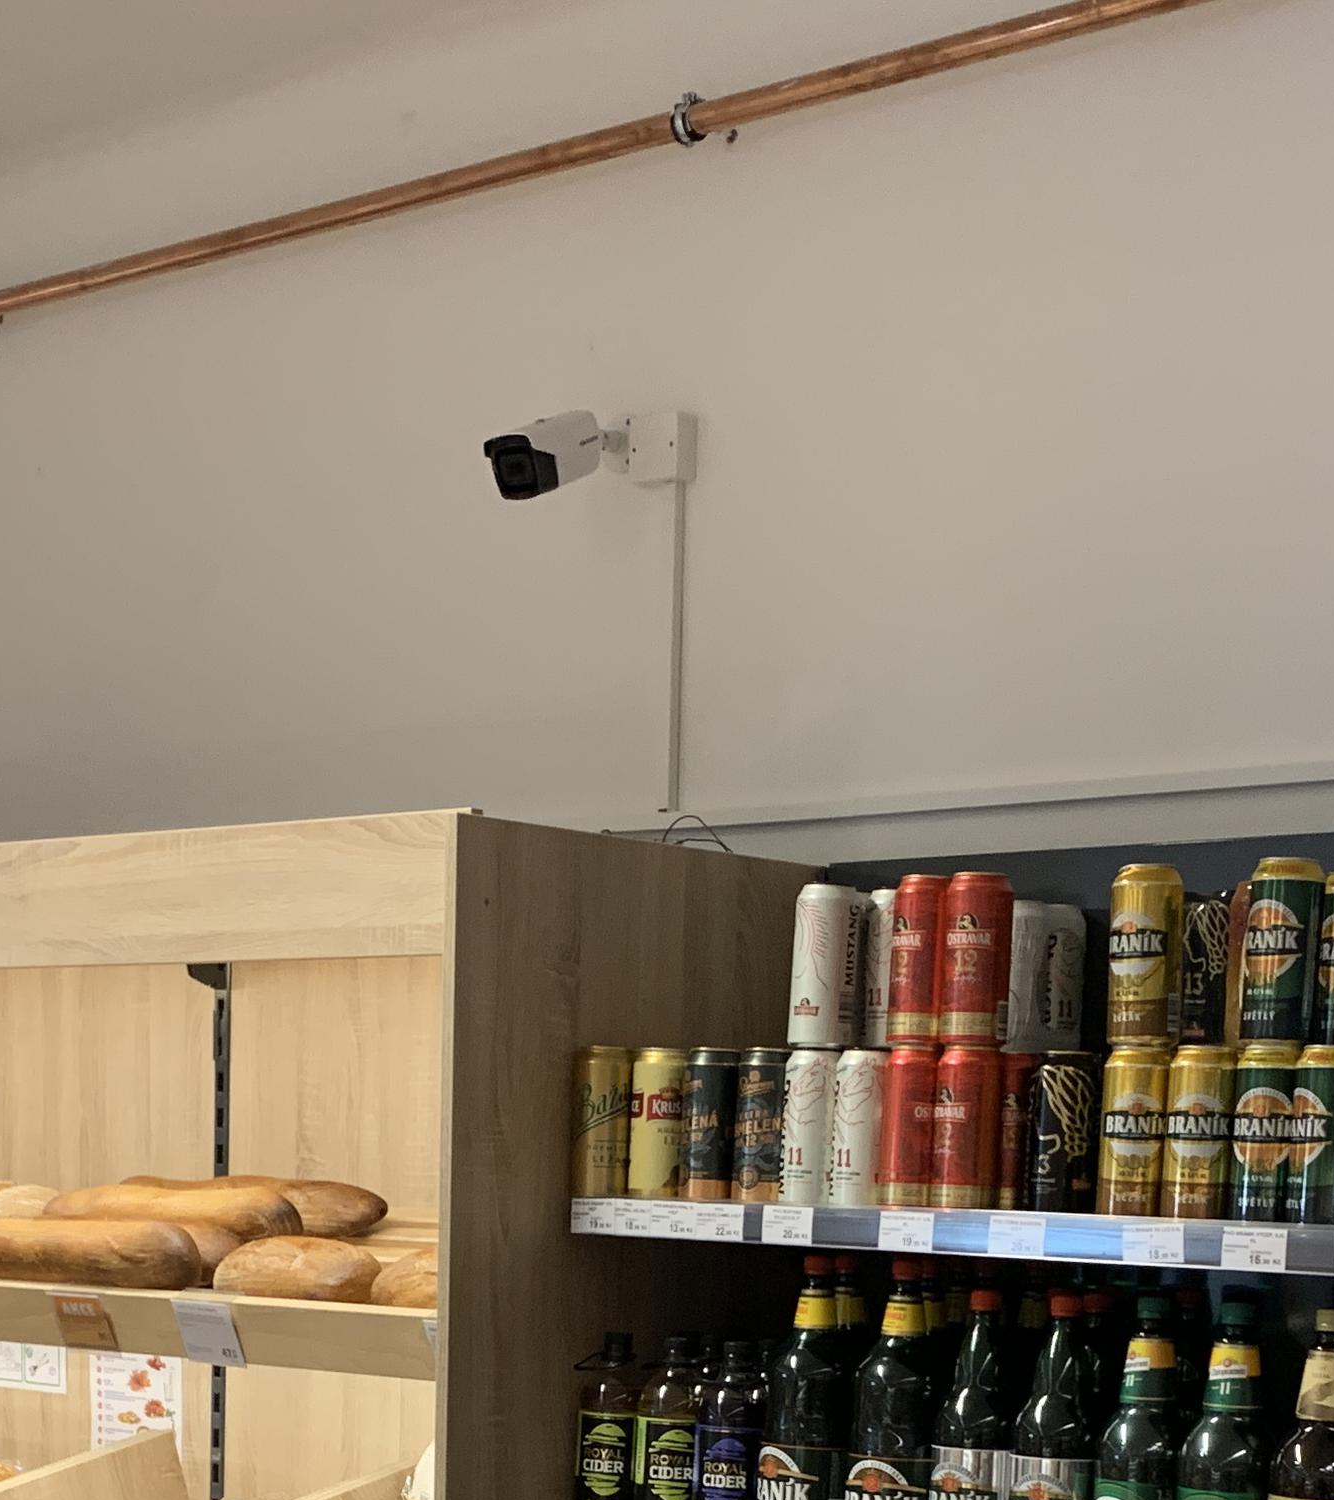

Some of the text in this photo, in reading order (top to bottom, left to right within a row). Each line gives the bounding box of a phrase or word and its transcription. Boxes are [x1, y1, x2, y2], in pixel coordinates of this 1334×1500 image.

[845, 904, 859, 987] MUSTANG
[1168, 1115, 1229, 1135] BRANÍK
[584, 1447, 622, 1463] ROYAL
[650, 1453, 692, 1467] ROYAL
[583, 1459, 624, 1475] CIDER
[649, 1465, 693, 1481] CIDER
[703, 1460, 747, 1475] ROYAL
[702, 1474, 747, 1490] CIDER
